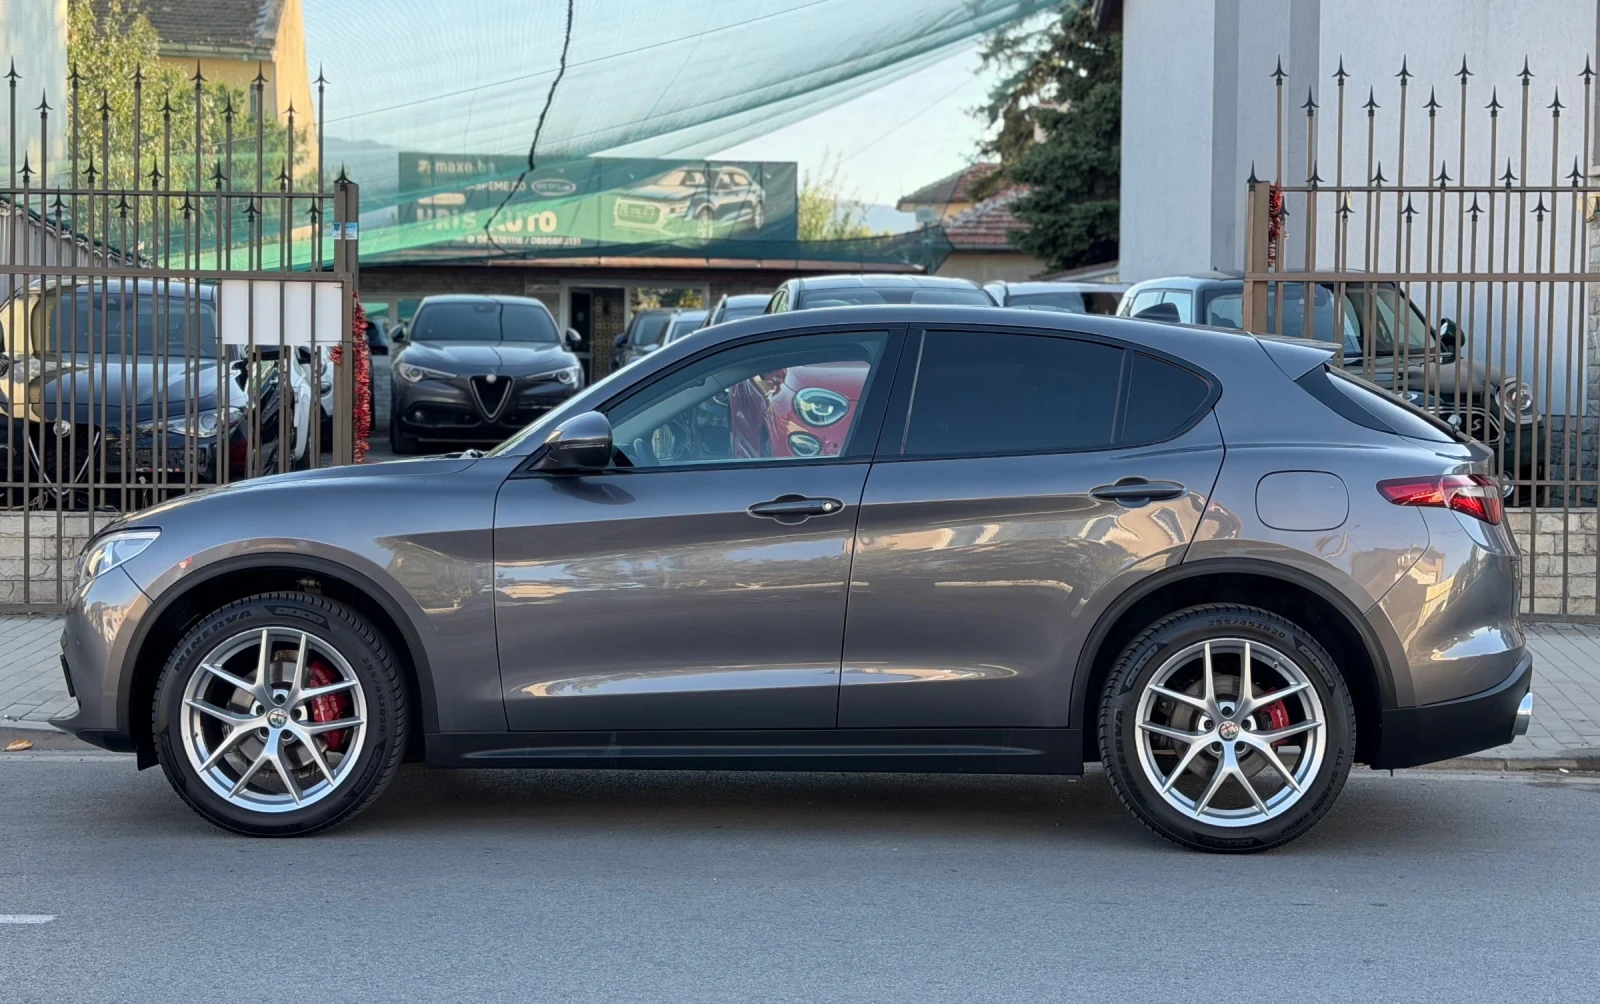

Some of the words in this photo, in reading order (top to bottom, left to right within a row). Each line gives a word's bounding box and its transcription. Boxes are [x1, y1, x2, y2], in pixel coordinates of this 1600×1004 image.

[490, 210, 557, 233] AUTO
[174, 610, 253, 673] MINERVA
[1207, 618, 1286, 639] 255/45ZR20
[361, 656, 387, 732] 255/45ZR20
[1334, 746, 1345, 768] ALL
[1310, 771, 1339, 814] SEASON
